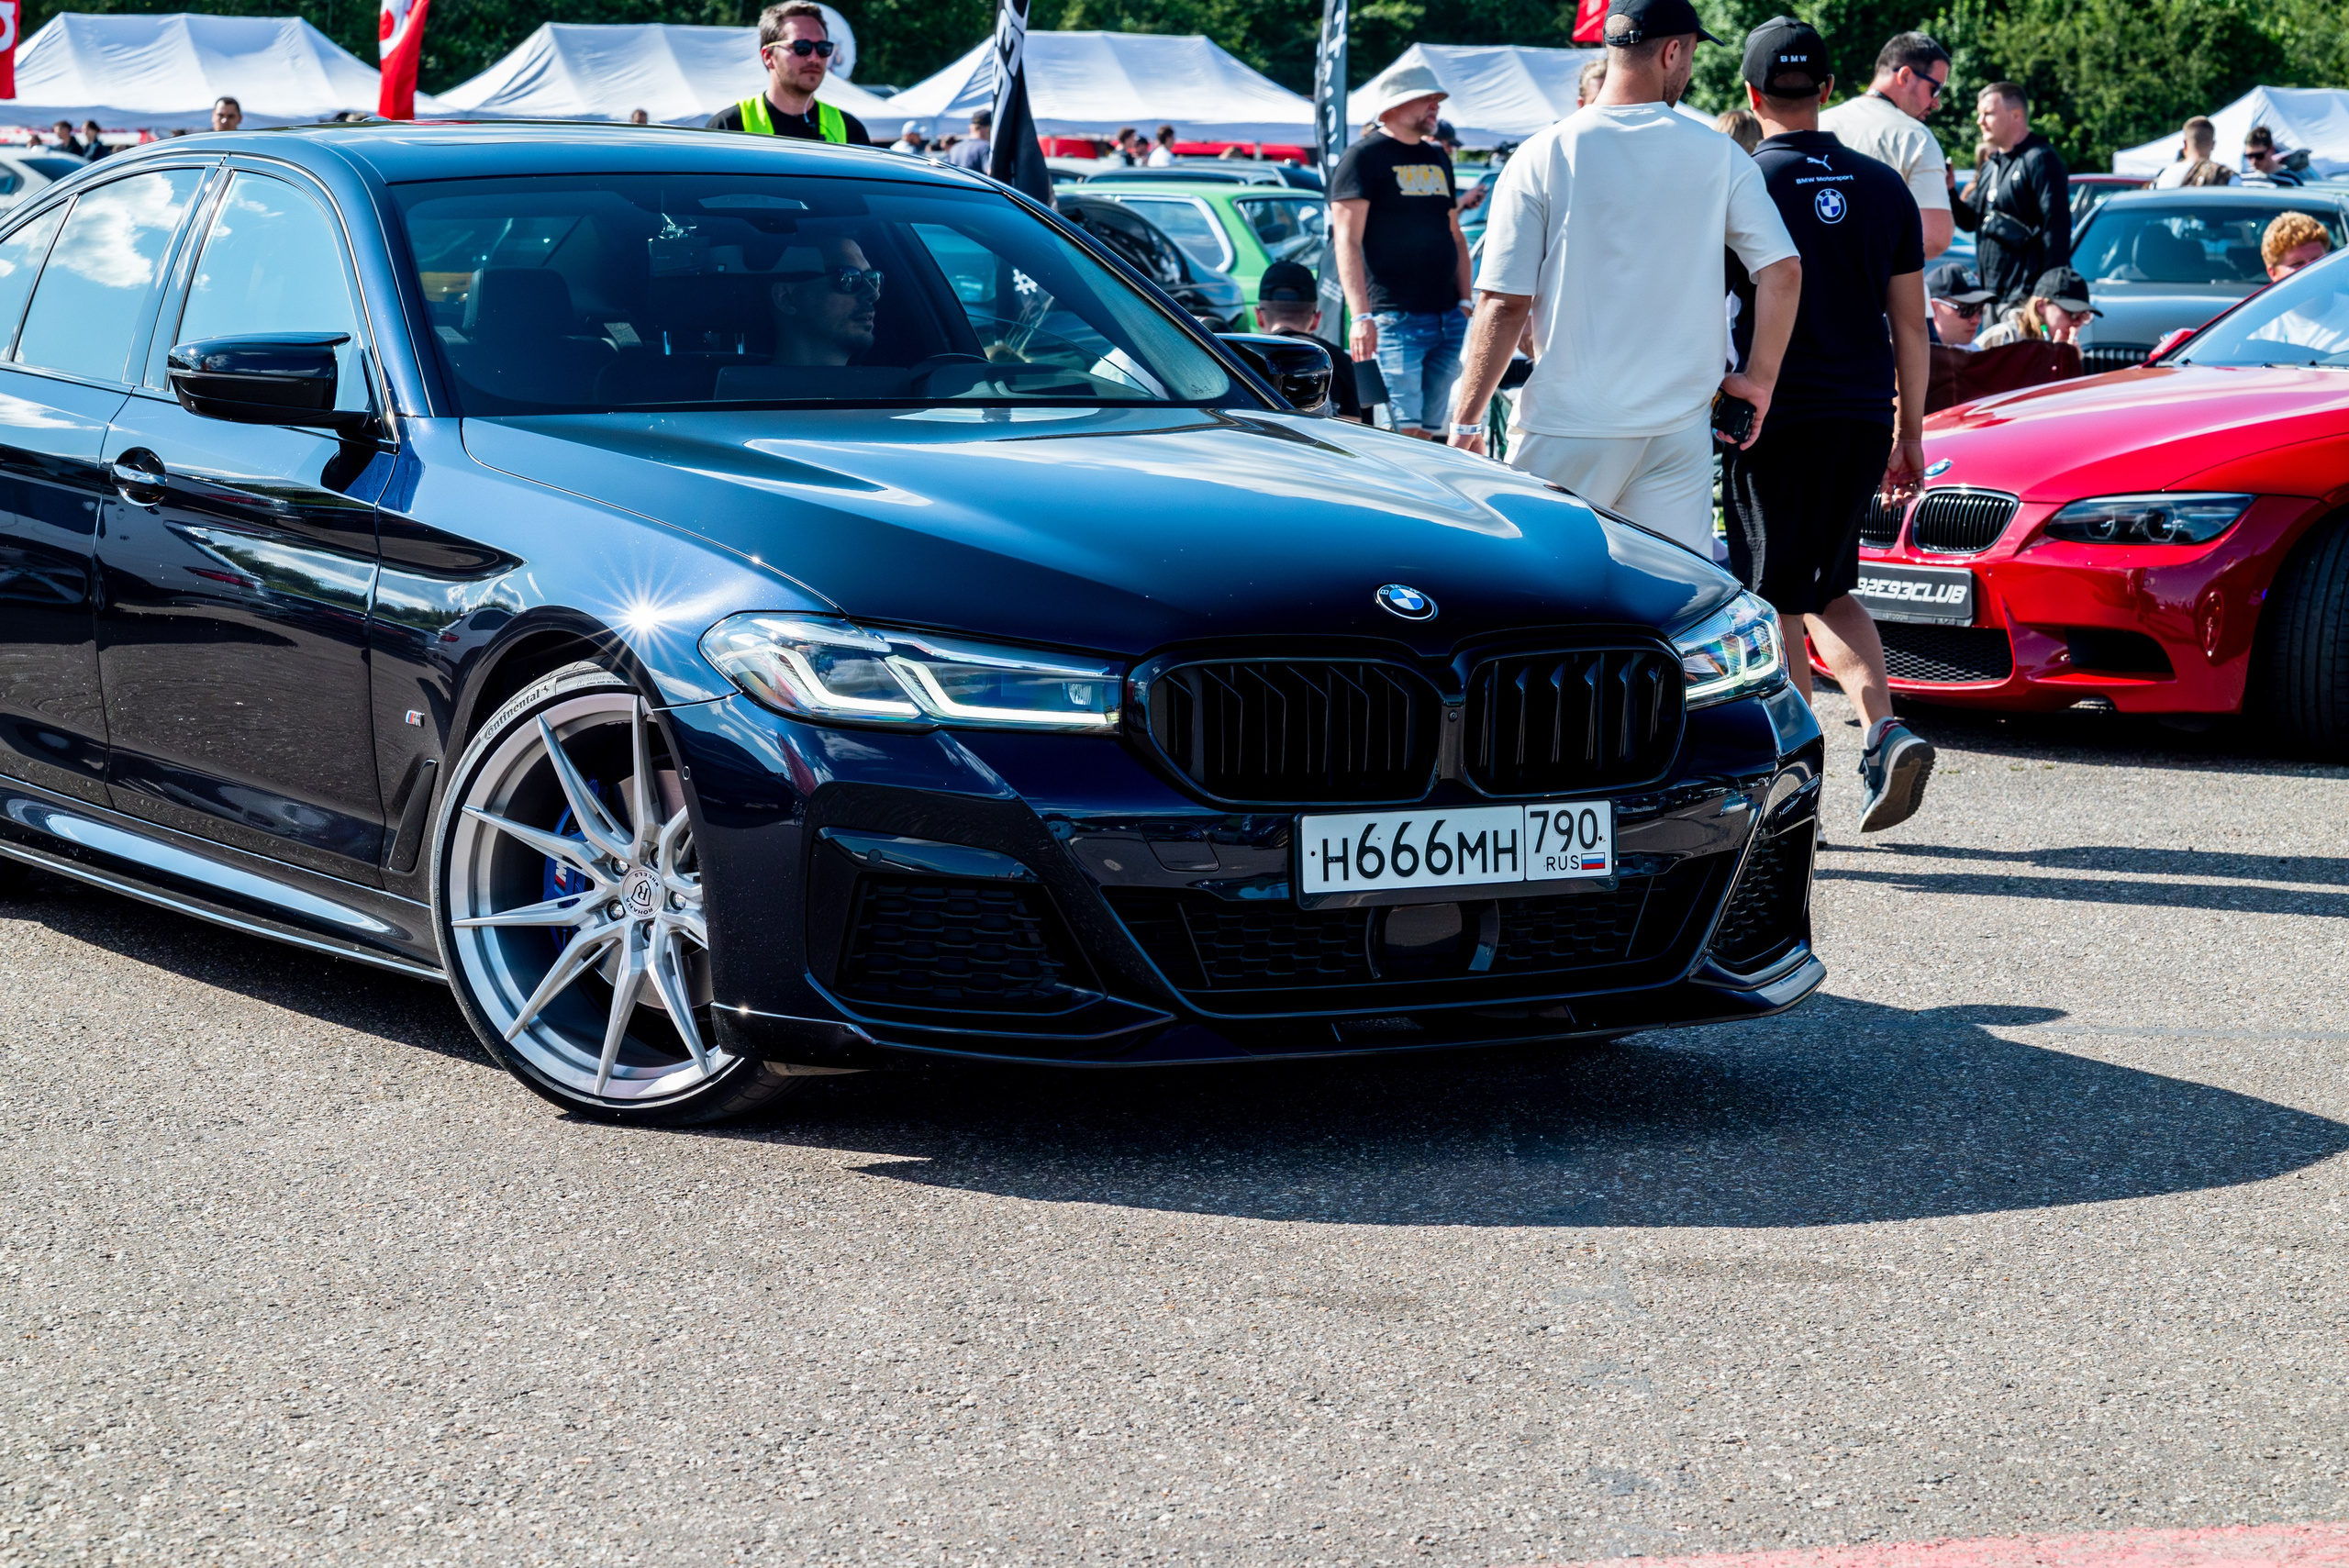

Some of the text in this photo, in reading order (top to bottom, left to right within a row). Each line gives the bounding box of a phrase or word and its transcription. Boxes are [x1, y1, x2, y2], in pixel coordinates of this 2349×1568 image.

[1848, 577, 1968, 605] 92E93CLUB
[484, 687, 541, 740] Continental
[1530, 808, 1598, 854] 790
[1546, 854, 1579, 872] RUS
[634, 872, 660, 887] WHEELS
[625, 897, 653, 915] ROHANA
